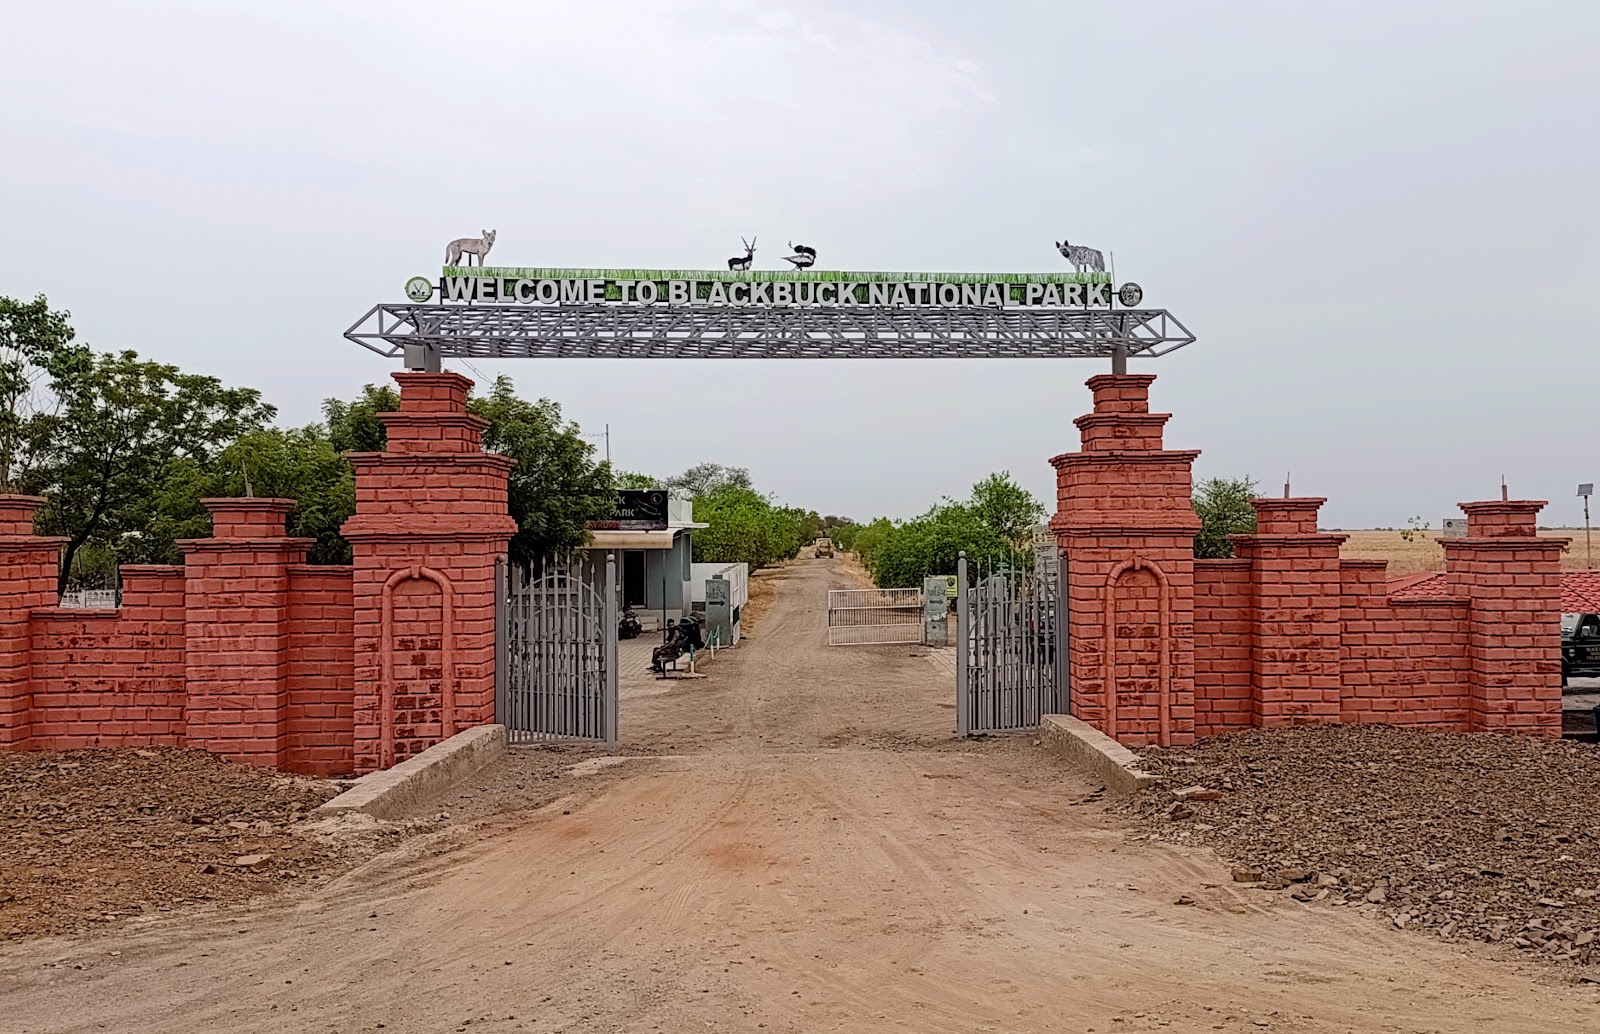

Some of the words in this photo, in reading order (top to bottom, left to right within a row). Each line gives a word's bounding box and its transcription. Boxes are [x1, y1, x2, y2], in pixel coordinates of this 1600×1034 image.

[446, 277, 605, 303] WELCOME
[616, 280, 658, 305] TO
[669, 281, 859, 307] BLACKBUCK
[868, 282, 1020, 307] NATIONAL
[1026, 283, 1108, 307] PARK
[609, 508, 635, 517] PARK
